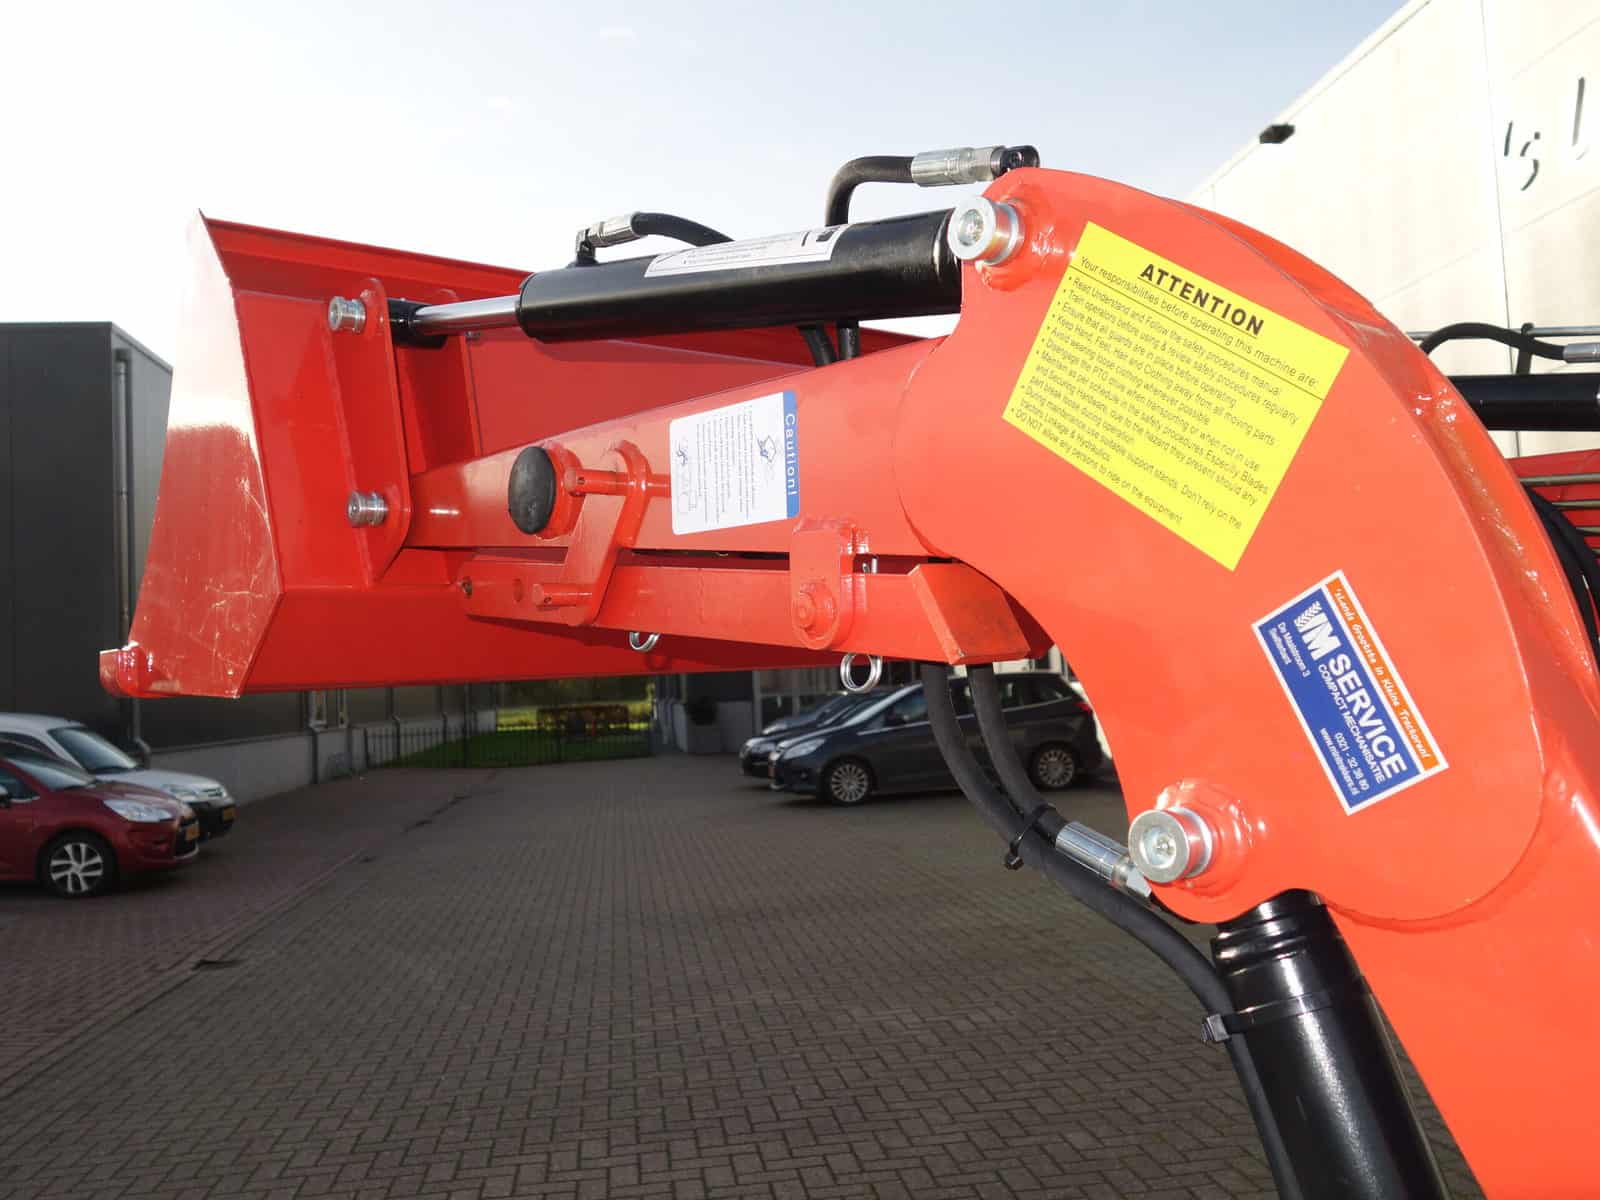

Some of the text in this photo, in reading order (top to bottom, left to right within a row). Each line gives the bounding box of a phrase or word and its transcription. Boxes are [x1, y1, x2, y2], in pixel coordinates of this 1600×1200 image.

[1079, 256, 1099, 273] Your
[1097, 266, 1160, 307] responsibilities
[1159, 298, 1189, 320] before
[1188, 313, 1234, 346] operating
[1234, 337, 1254, 354] this
[1253, 347, 1298, 377] machine
[1139, 261, 1265, 336] ATTENTION
[785, 413, 797, 495] Caution!
[1325, 650, 1408, 779] SERVICE
[1374, 665, 1386, 677] in
[1316, 662, 1385, 784] COMPACT MECHANISATIE
